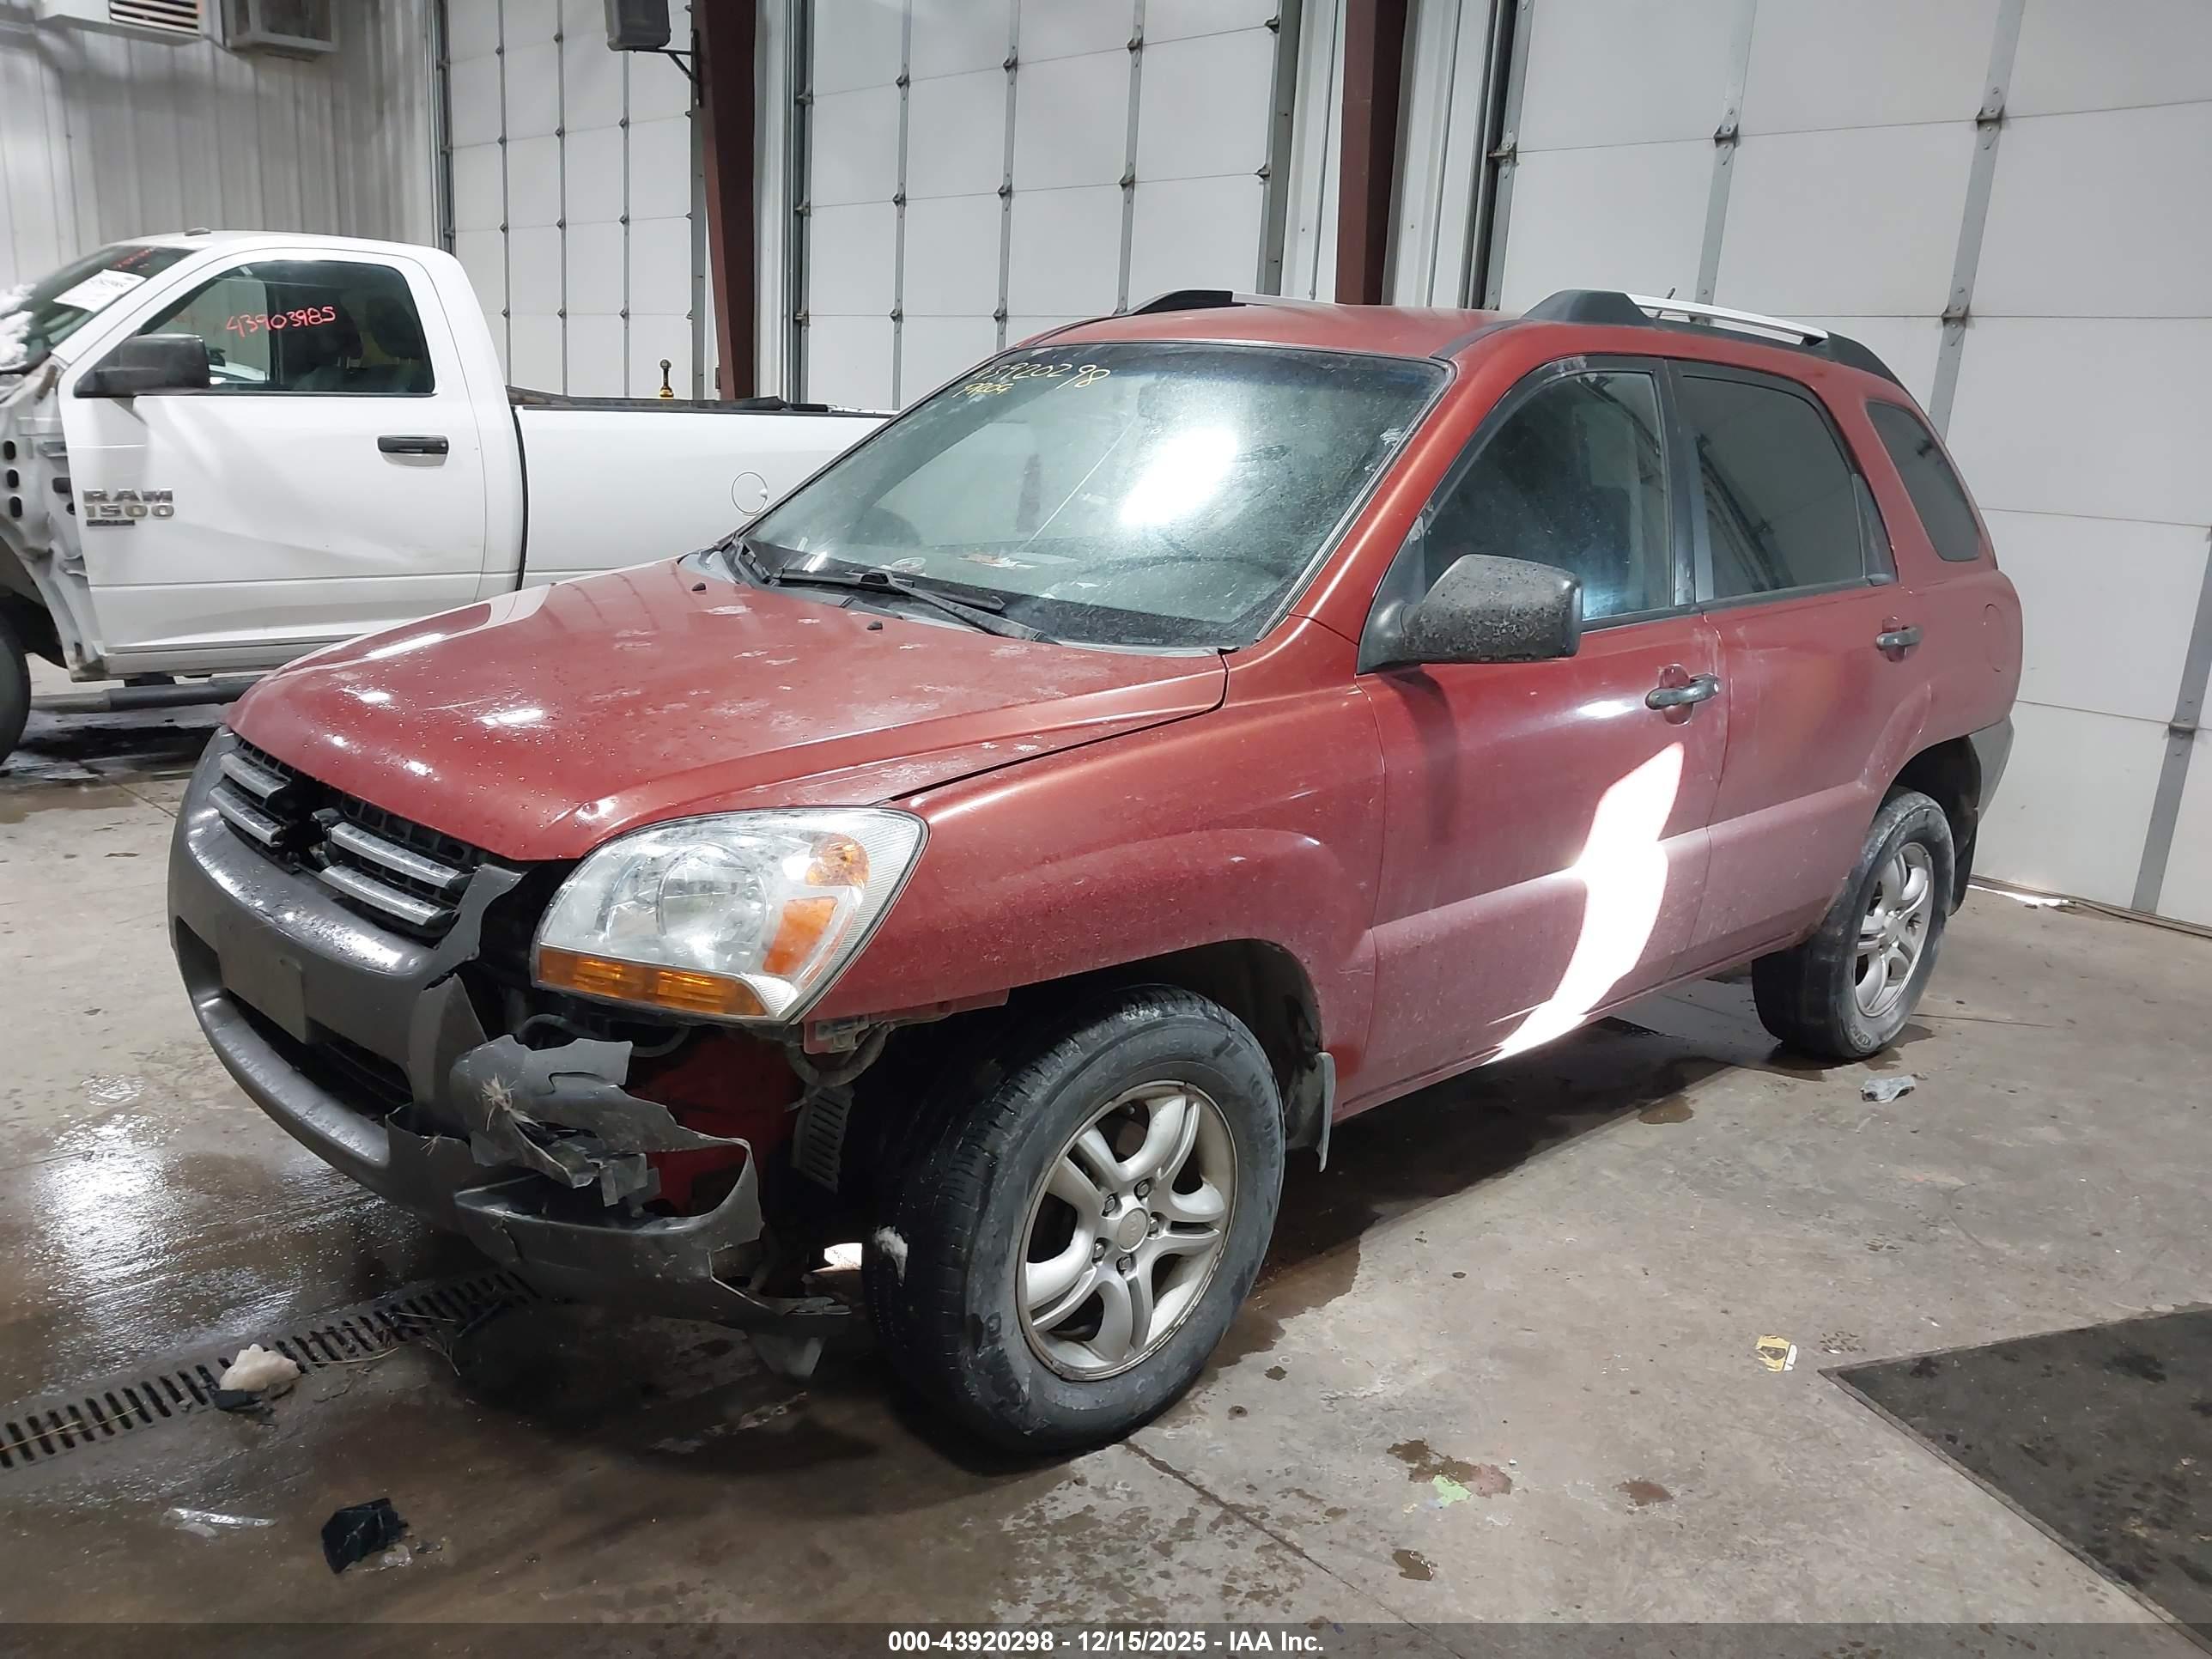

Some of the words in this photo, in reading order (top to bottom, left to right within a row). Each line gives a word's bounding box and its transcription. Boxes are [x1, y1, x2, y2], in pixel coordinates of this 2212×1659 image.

[226, 306, 337, 337] 43903985
[82, 489, 173, 502] RAM
[84, 503, 174, 518] 1500
